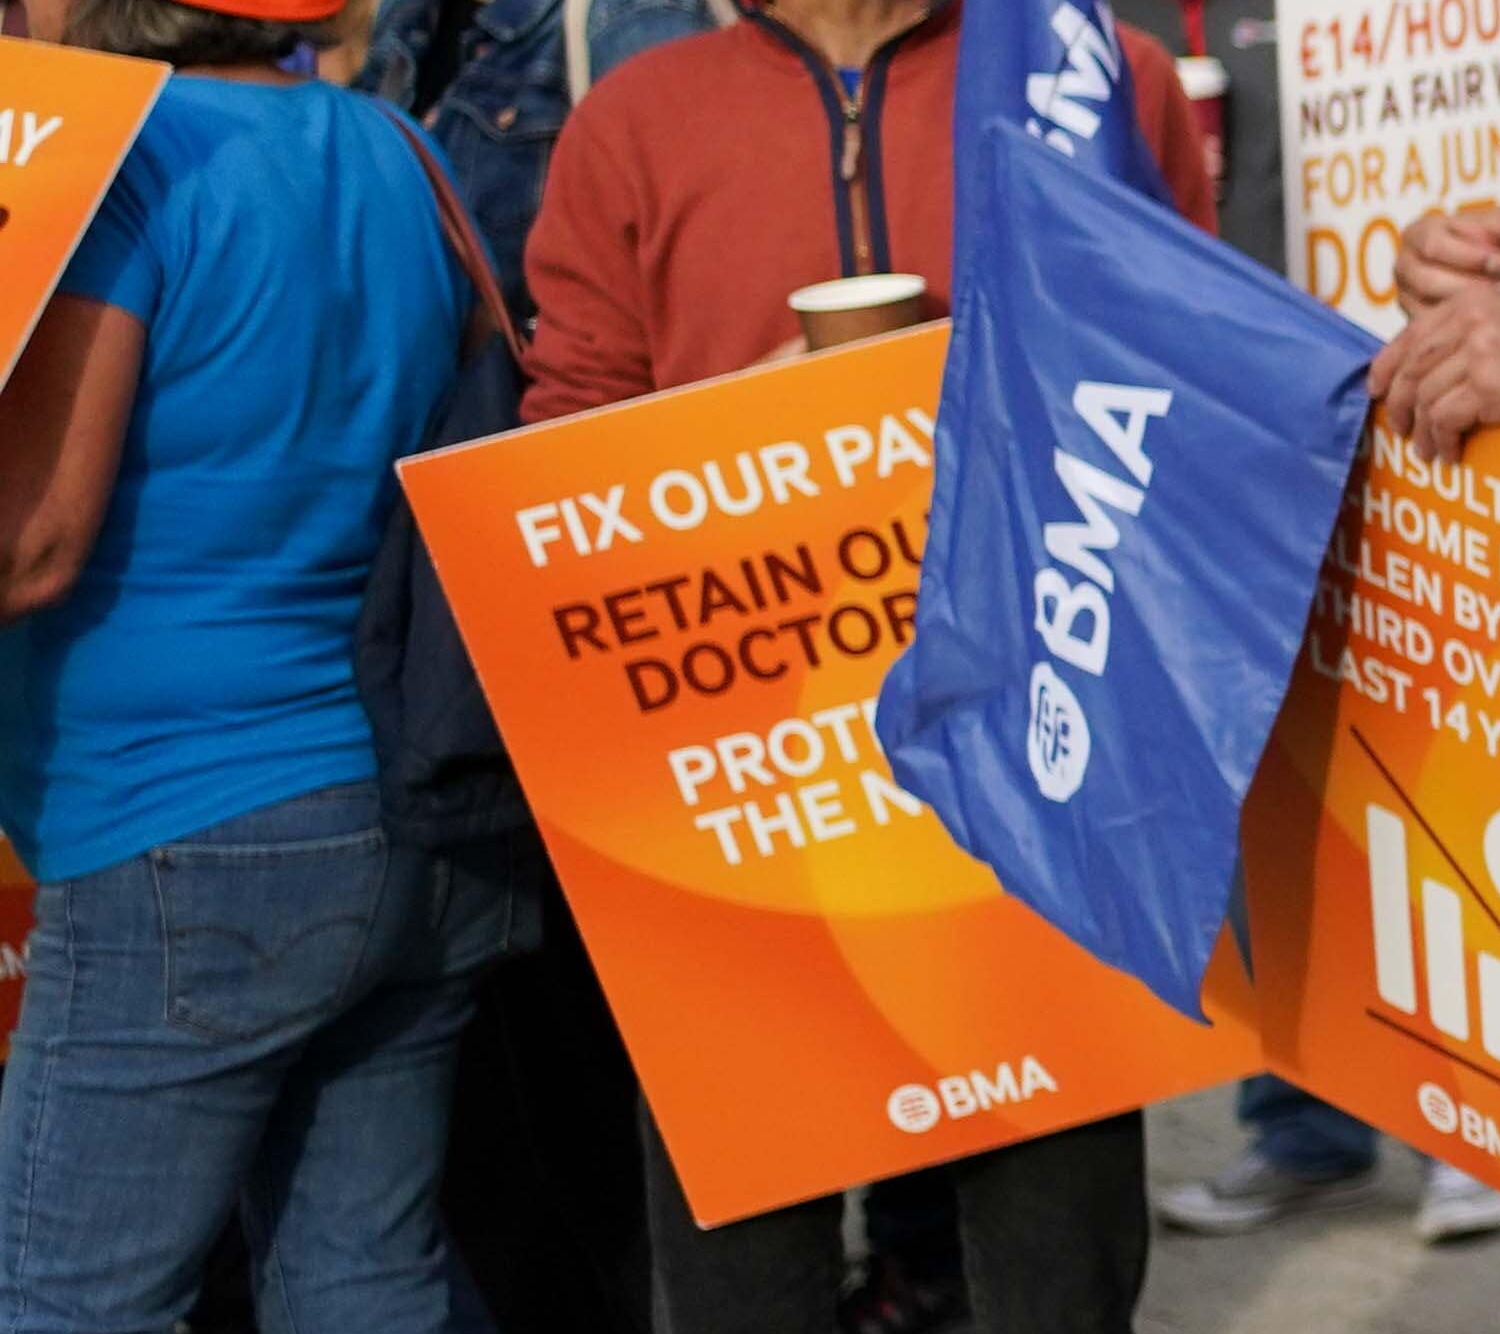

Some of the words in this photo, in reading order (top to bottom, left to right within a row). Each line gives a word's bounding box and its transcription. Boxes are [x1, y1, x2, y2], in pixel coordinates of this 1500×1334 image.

[1301, 84, 1367, 140] NOT
[1379, 80, 1401, 123] A
[1411, 62, 1485, 117] FAIR
[1302, 147, 1386, 213] FOR
[1400, 140, 1428, 197] A
[515, 484, 644, 568] FIX
[649, 441, 820, 531] OUR
[1034, 380, 1174, 677] BMA
[552, 543, 823, 660] RETAIN
[838, 511, 930, 581] OU
[624, 591, 918, 715] DOCTOR
[1311, 631, 1413, 714] LAST
[1423, 687, 1470, 744] 14
[668, 698, 885, 807] PROT
[694, 780, 857, 865] THE
[937, 1054, 1059, 1120] BMA
